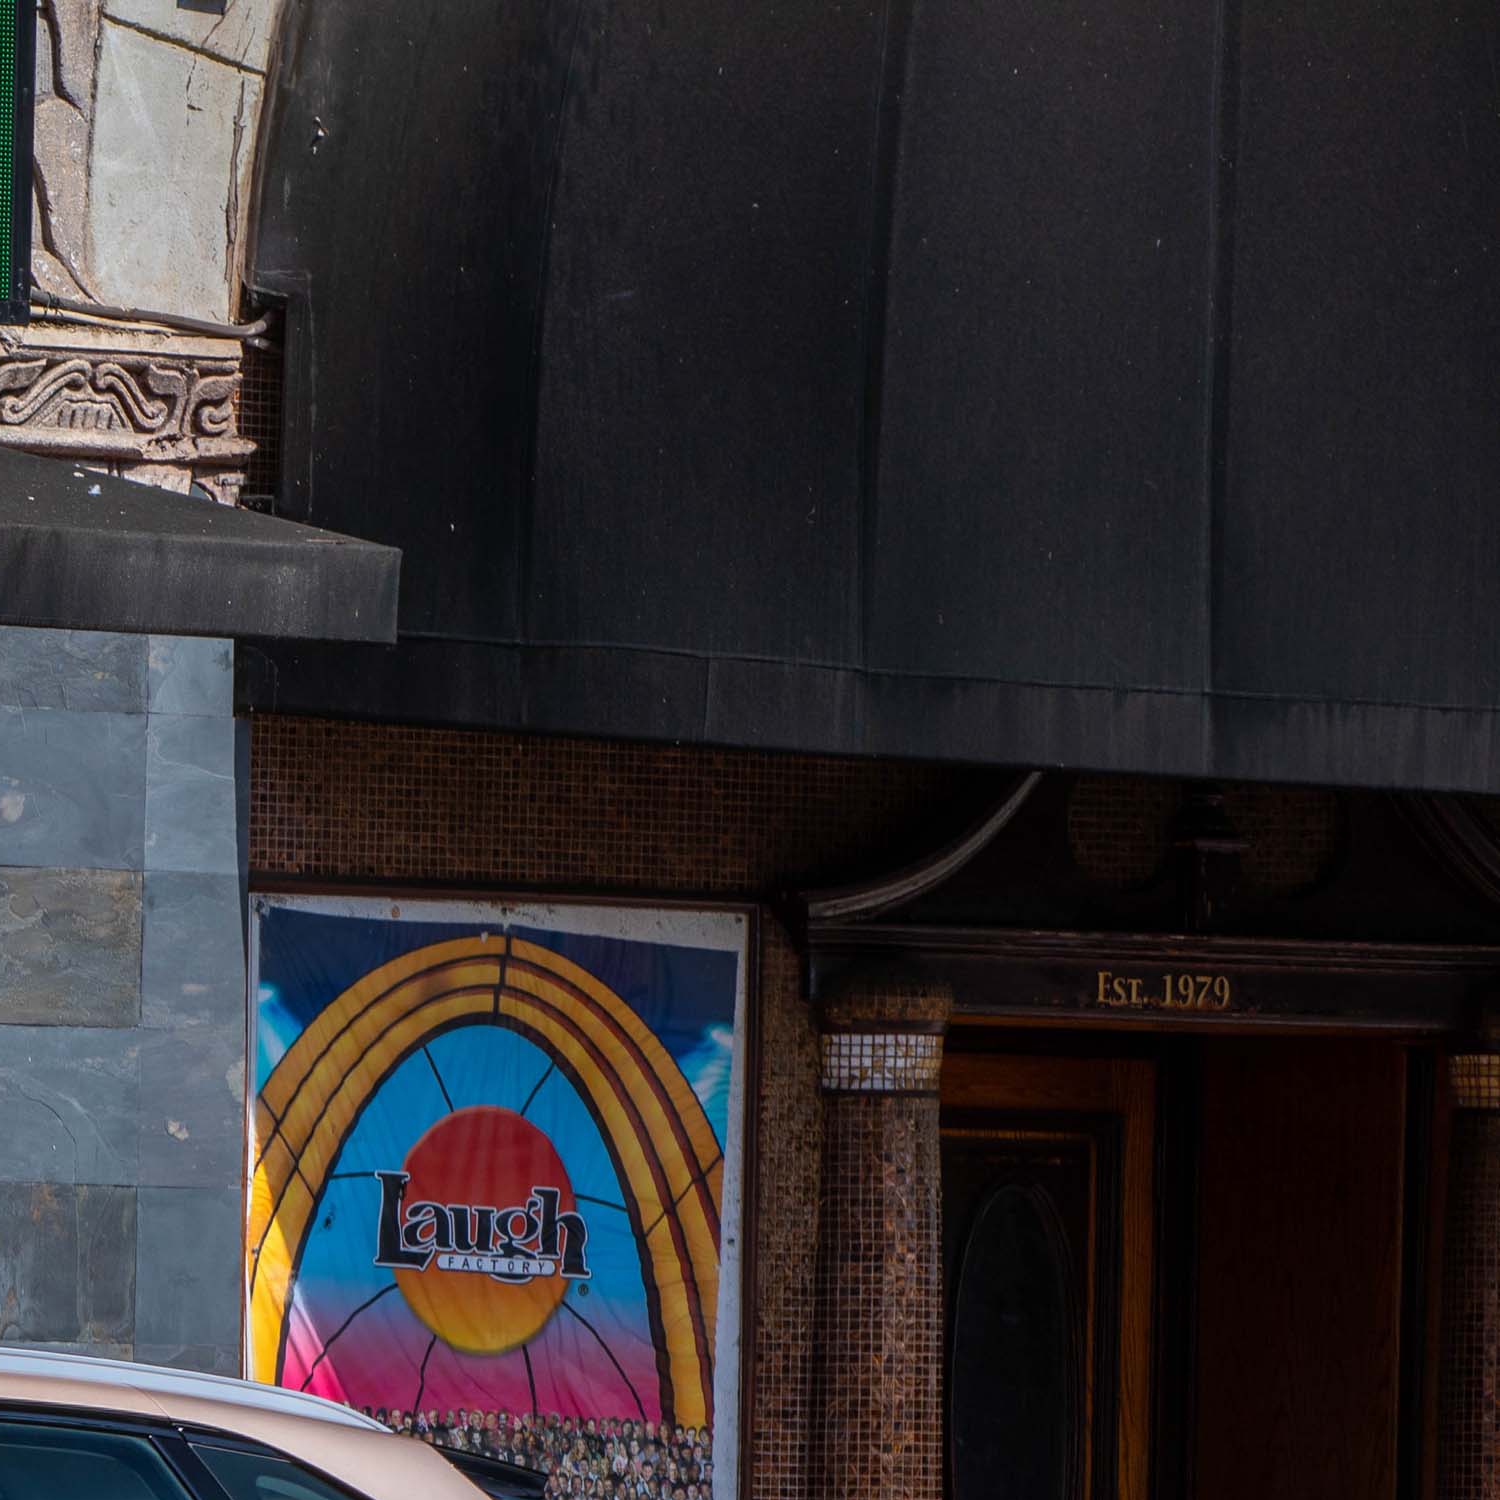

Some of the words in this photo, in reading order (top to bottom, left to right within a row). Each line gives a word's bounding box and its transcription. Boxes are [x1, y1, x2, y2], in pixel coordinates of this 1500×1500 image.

[1160, 974, 1231, 1009] 1979
[373, 1170, 591, 1284] Laugh
[447, 1256, 546, 1274] FACTORY
